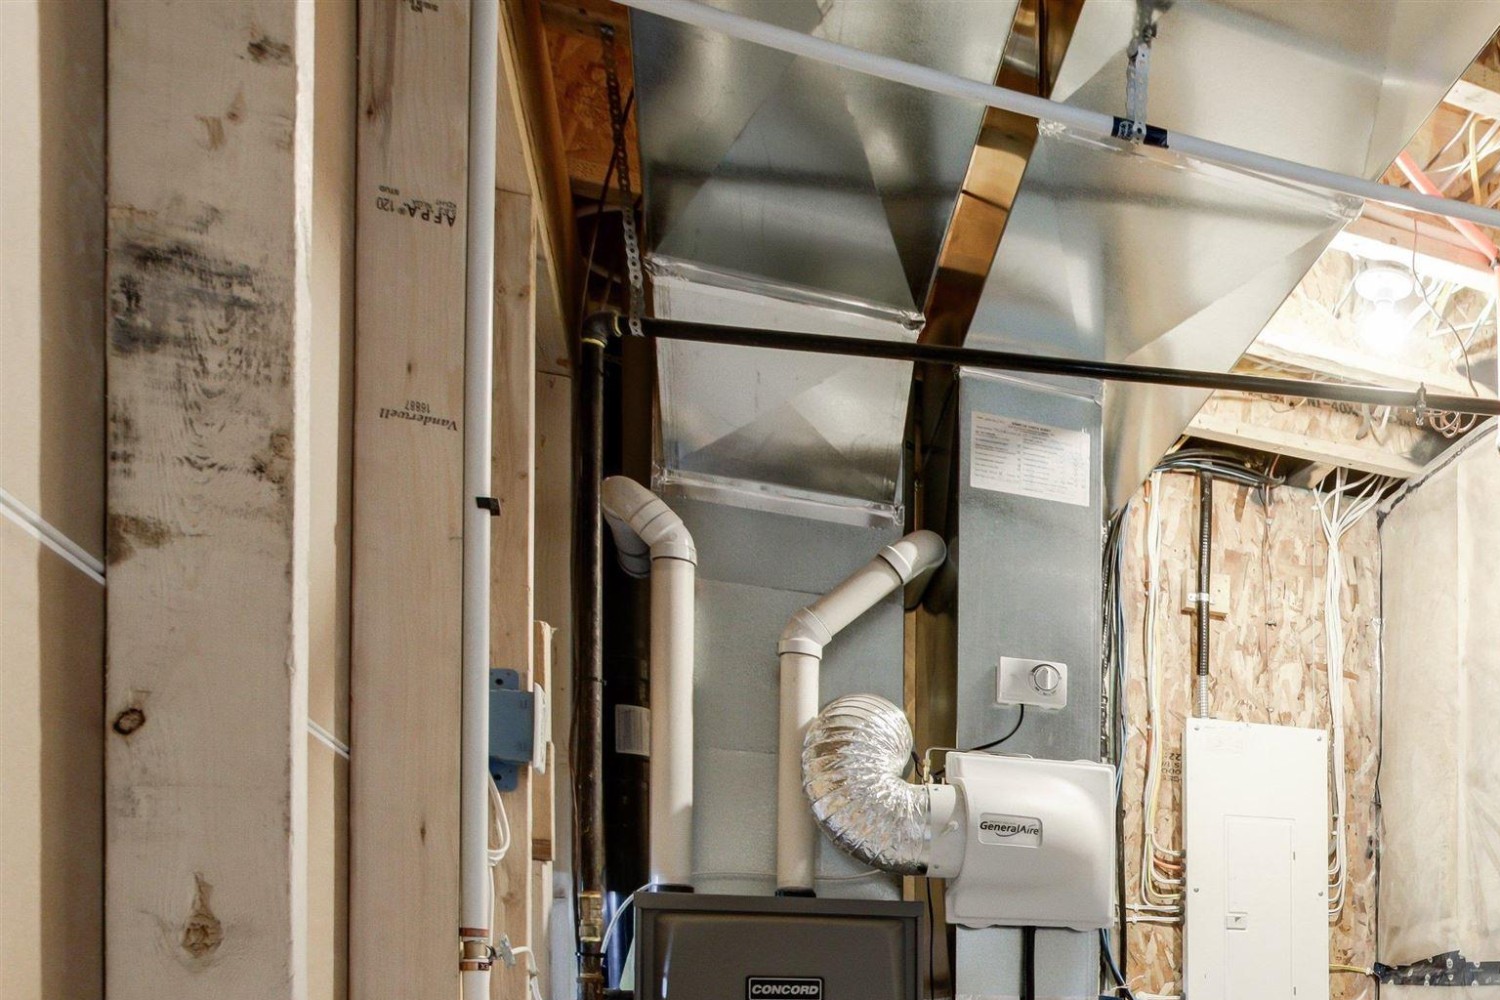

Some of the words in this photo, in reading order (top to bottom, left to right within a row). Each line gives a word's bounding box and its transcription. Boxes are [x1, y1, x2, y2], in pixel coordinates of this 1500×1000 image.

[379, 185, 399, 195] STUD
[376, 197, 394, 212] 120
[380, 408, 458, 431] Vanderwell
[980, 821, 1039, 837] GeneralAire
[752, 984, 818, 994] CONCORD
